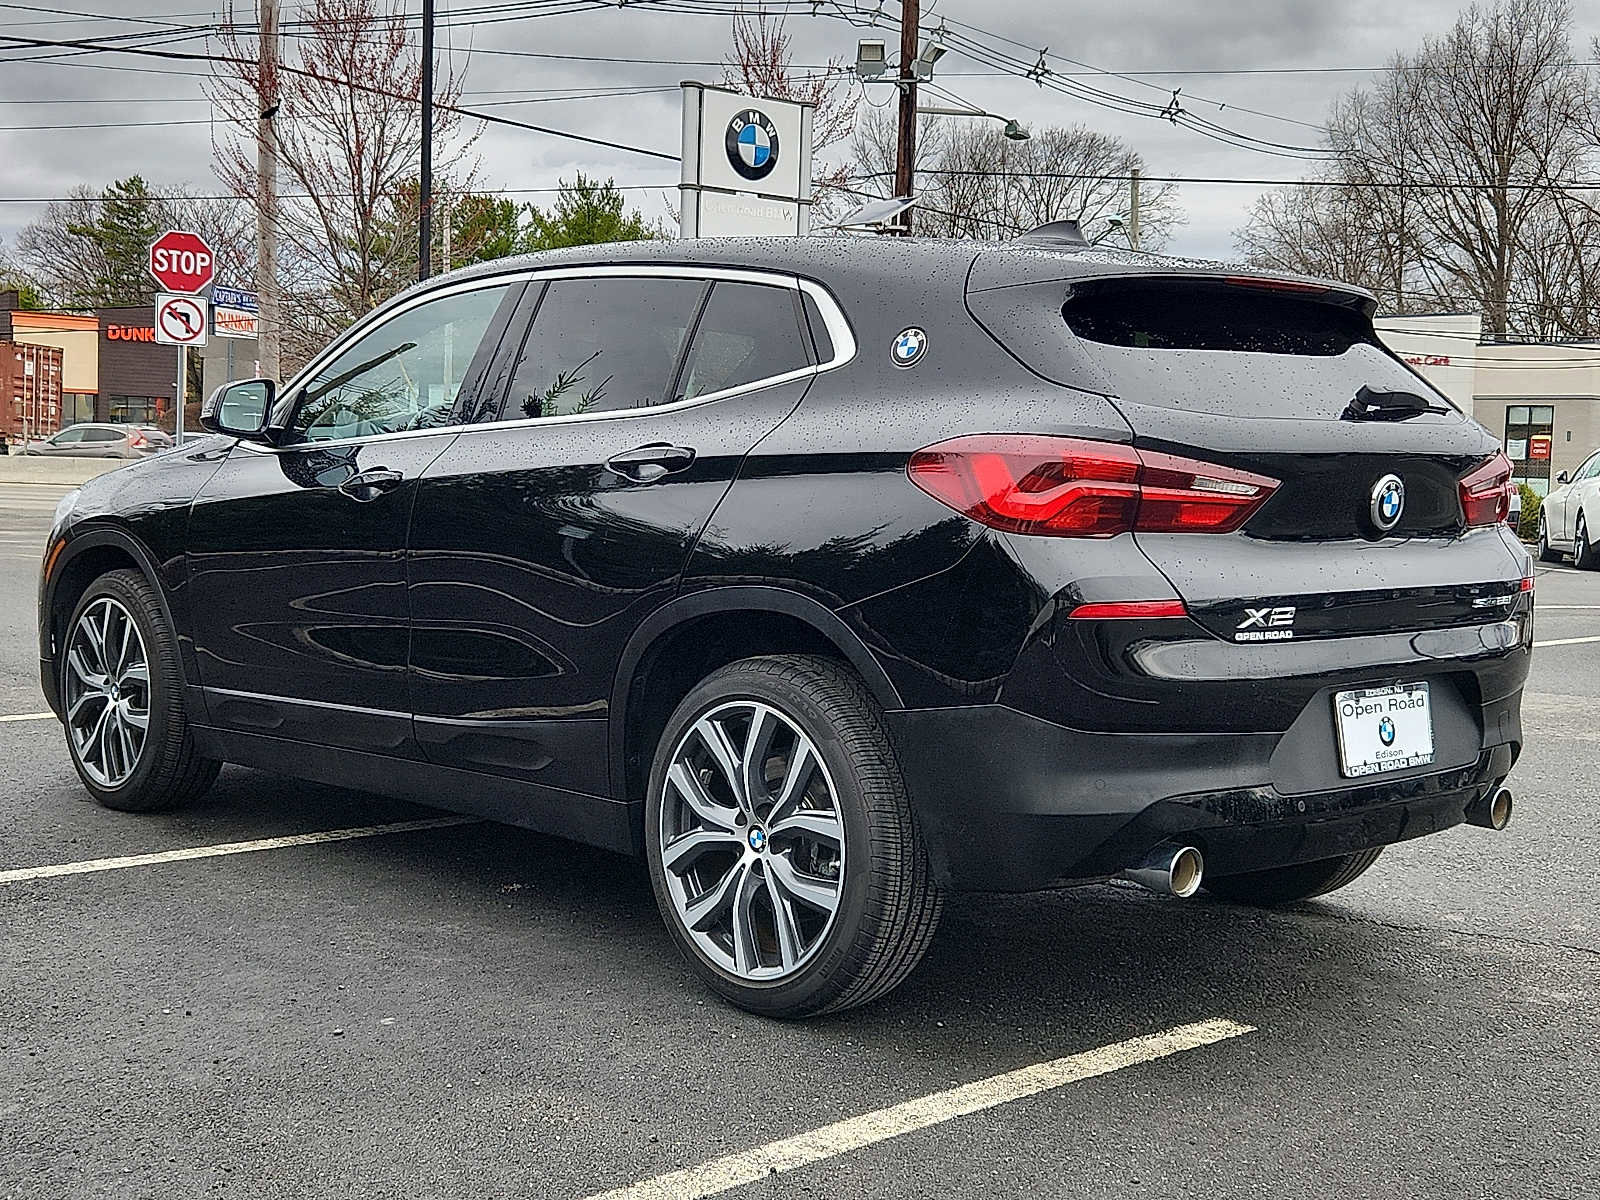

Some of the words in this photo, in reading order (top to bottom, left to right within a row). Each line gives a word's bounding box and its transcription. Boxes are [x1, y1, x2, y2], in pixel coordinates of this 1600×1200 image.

[732, 112, 776, 138] BMW
[154, 248, 211, 276] STOP
[1235, 606, 1297, 629] X2
[1234, 631, 1264, 641] OPEN
[1265, 630, 1293, 640] ROAD
[1394, 685, 1404, 695] NJ
[1342, 703, 1383, 719] Open
[1388, 694, 1425, 712] Road
[1351, 761, 1381, 776] OPEN
[1381, 757, 1407, 772] ROAD
[1408, 753, 1432, 767] BMW
[1375, 749, 1404, 760] Edison
